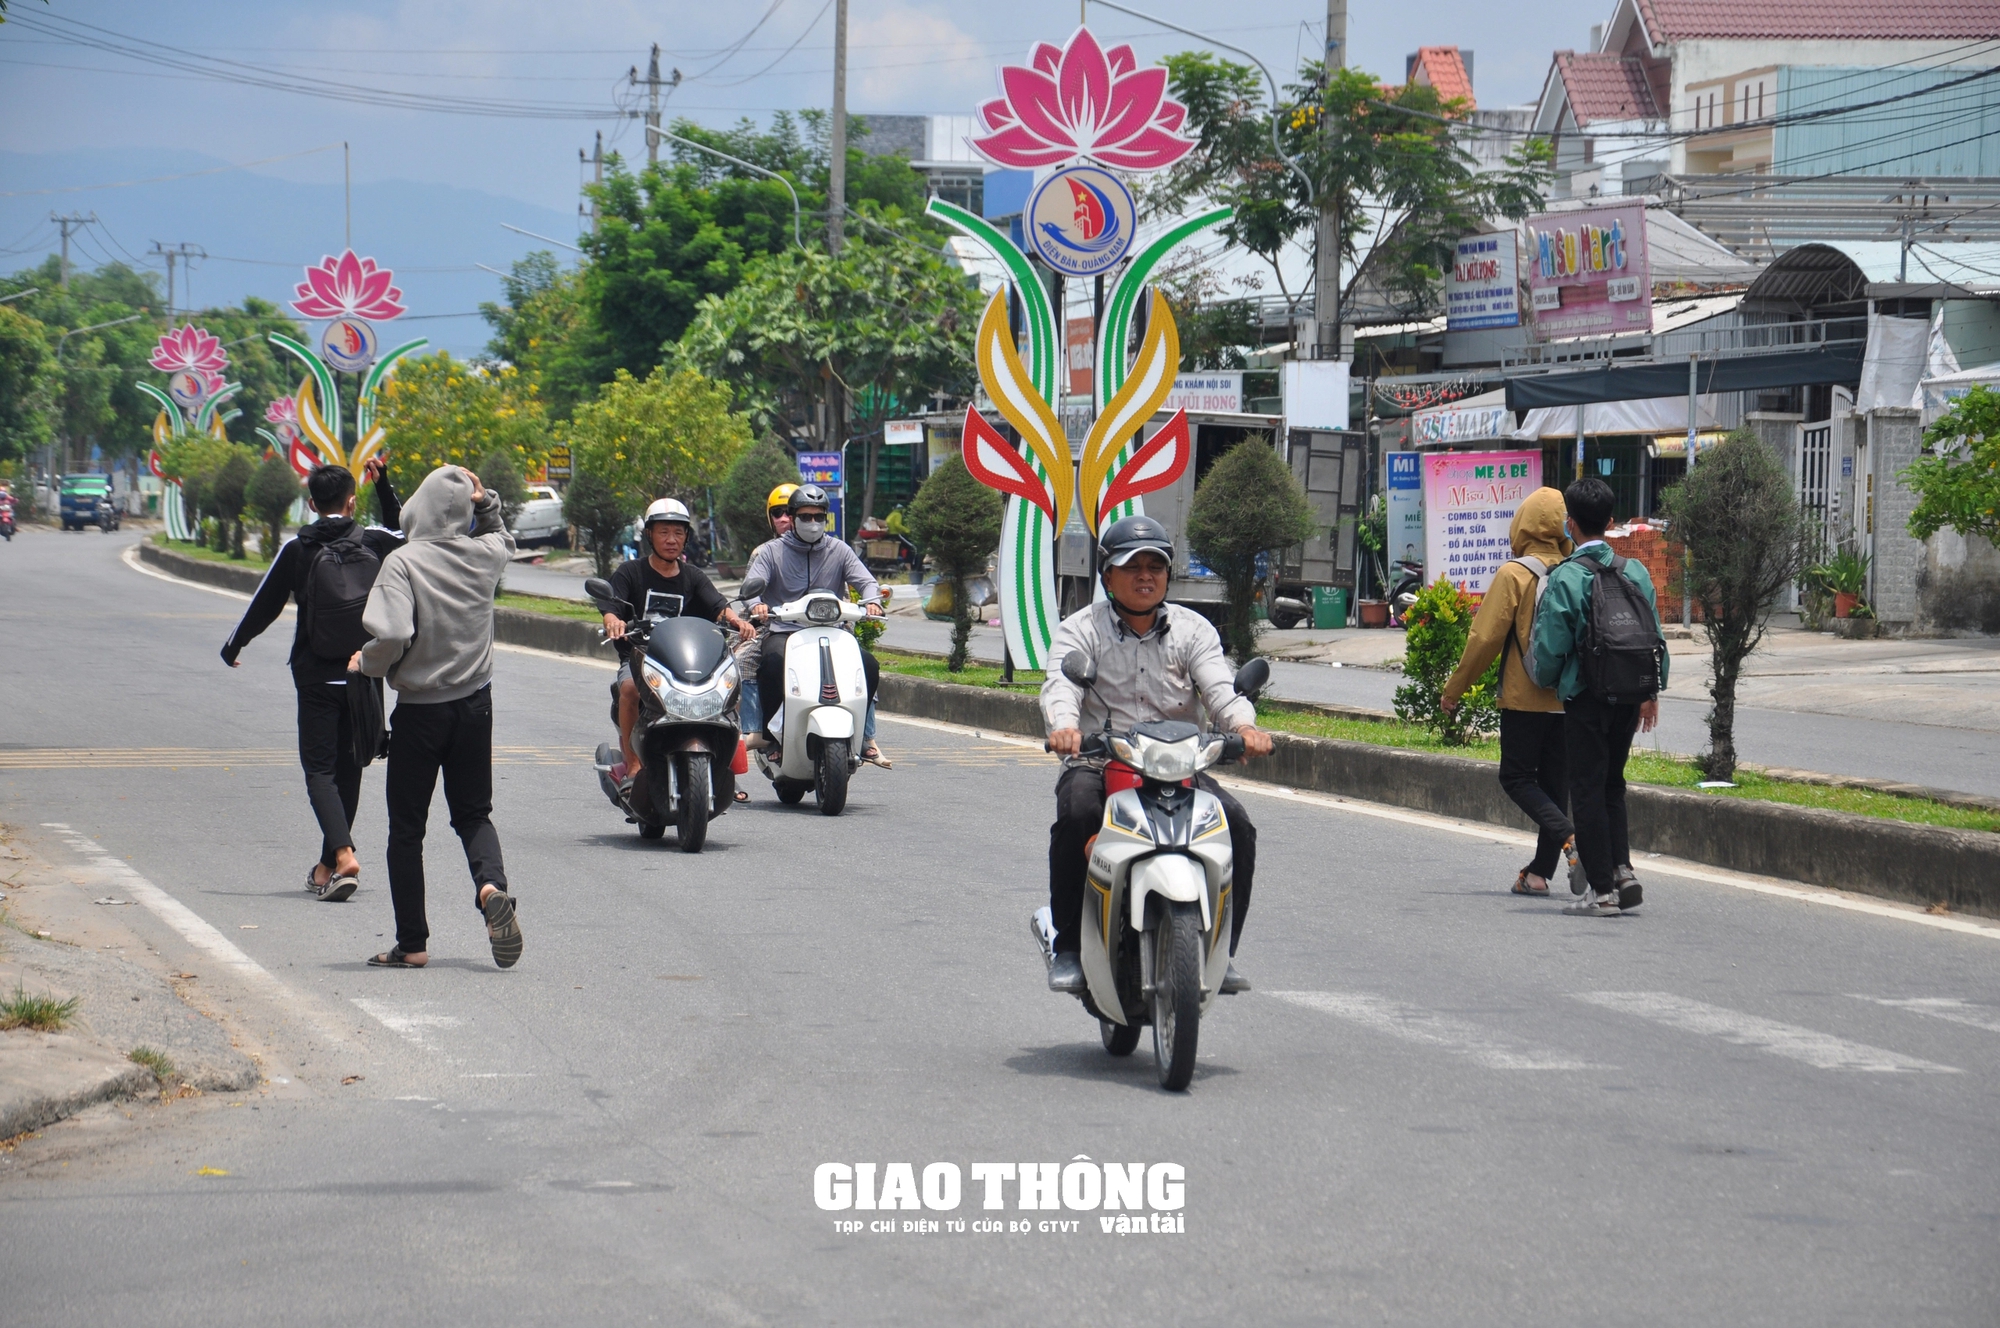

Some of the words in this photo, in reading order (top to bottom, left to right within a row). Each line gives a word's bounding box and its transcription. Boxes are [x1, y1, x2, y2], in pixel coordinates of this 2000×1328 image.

[1042, 240, 1061, 260] ĐIỆN
[1081, 253, 1111, 269] QUẢNG
[1110, 237, 1126, 257] NAM
[1580, 218, 1624, 273] Mart
[1172, 380, 1183, 389] NG
[1184, 378, 1205, 389] KHÁM
[1206, 378, 1218, 391] NỘI
[1220, 379, 1232, 389] SOI
[1203, 394, 1237, 411] HỌNG
[1454, 410, 1503, 439] MART
[1474, 465, 1495, 482] MẸ
[1498, 465, 1507, 479] &
[1510, 460, 1528, 478] BÉ
[1448, 484, 1484, 507] Misu
[1486, 482, 1524, 505] Mart
[1447, 511, 1478, 521] COMBO
[1494, 510, 1515, 519] SINH
[1469, 580, 1480, 589] XE
